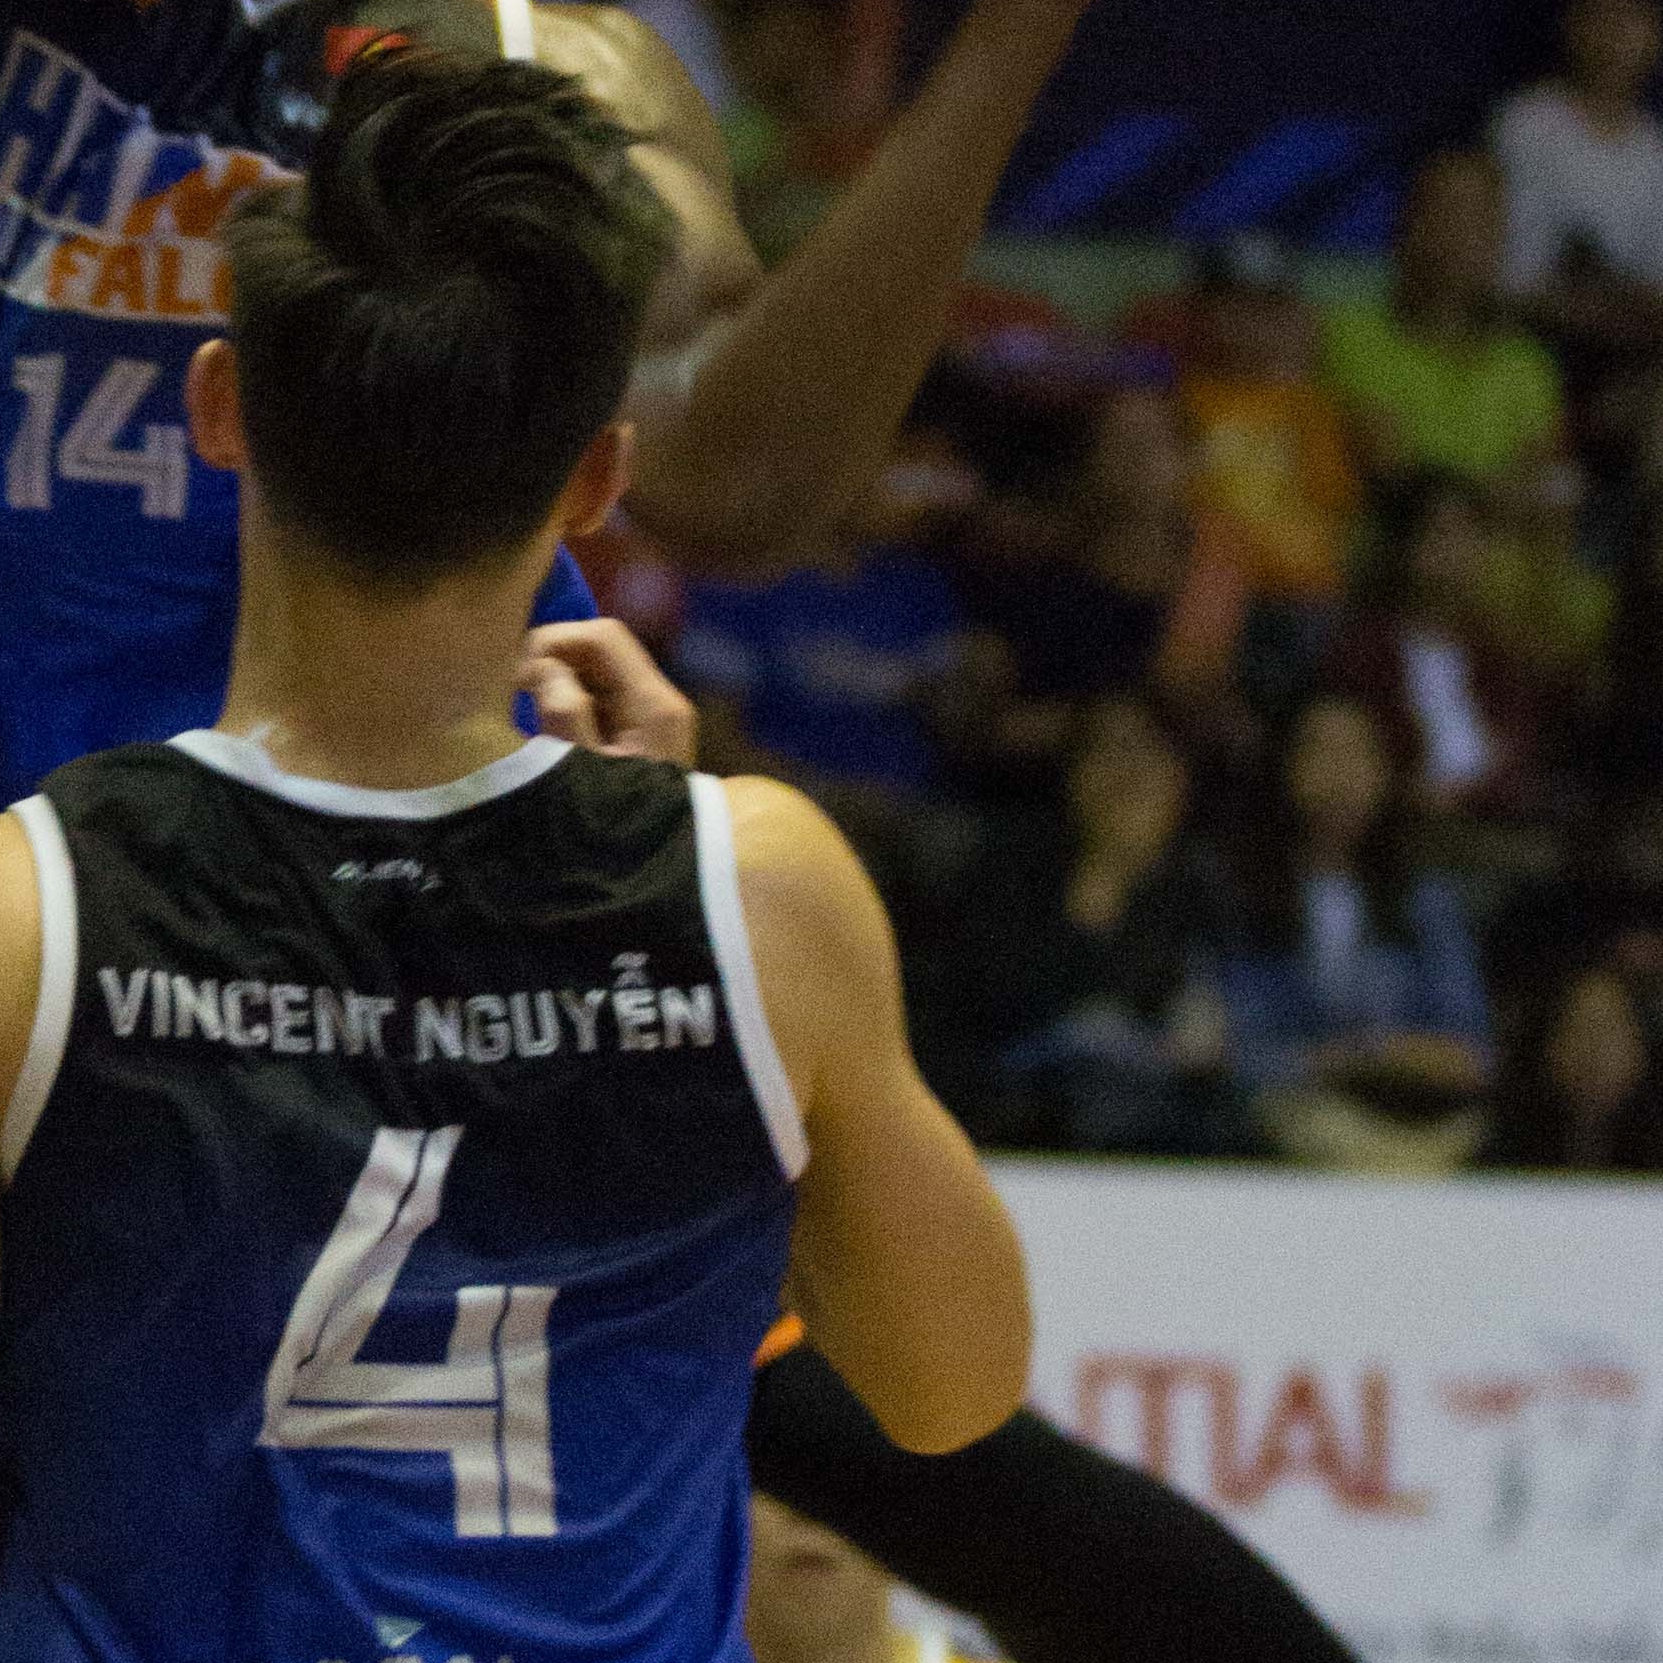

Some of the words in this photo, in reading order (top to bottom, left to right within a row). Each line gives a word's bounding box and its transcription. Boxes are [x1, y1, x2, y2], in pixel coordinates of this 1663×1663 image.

[5, 350, 190, 522] 14
[96, 966, 396, 1060] VINCENT
[413, 950, 719, 1065] NGUYỄN
[255, 1123, 559, 1539] 4
